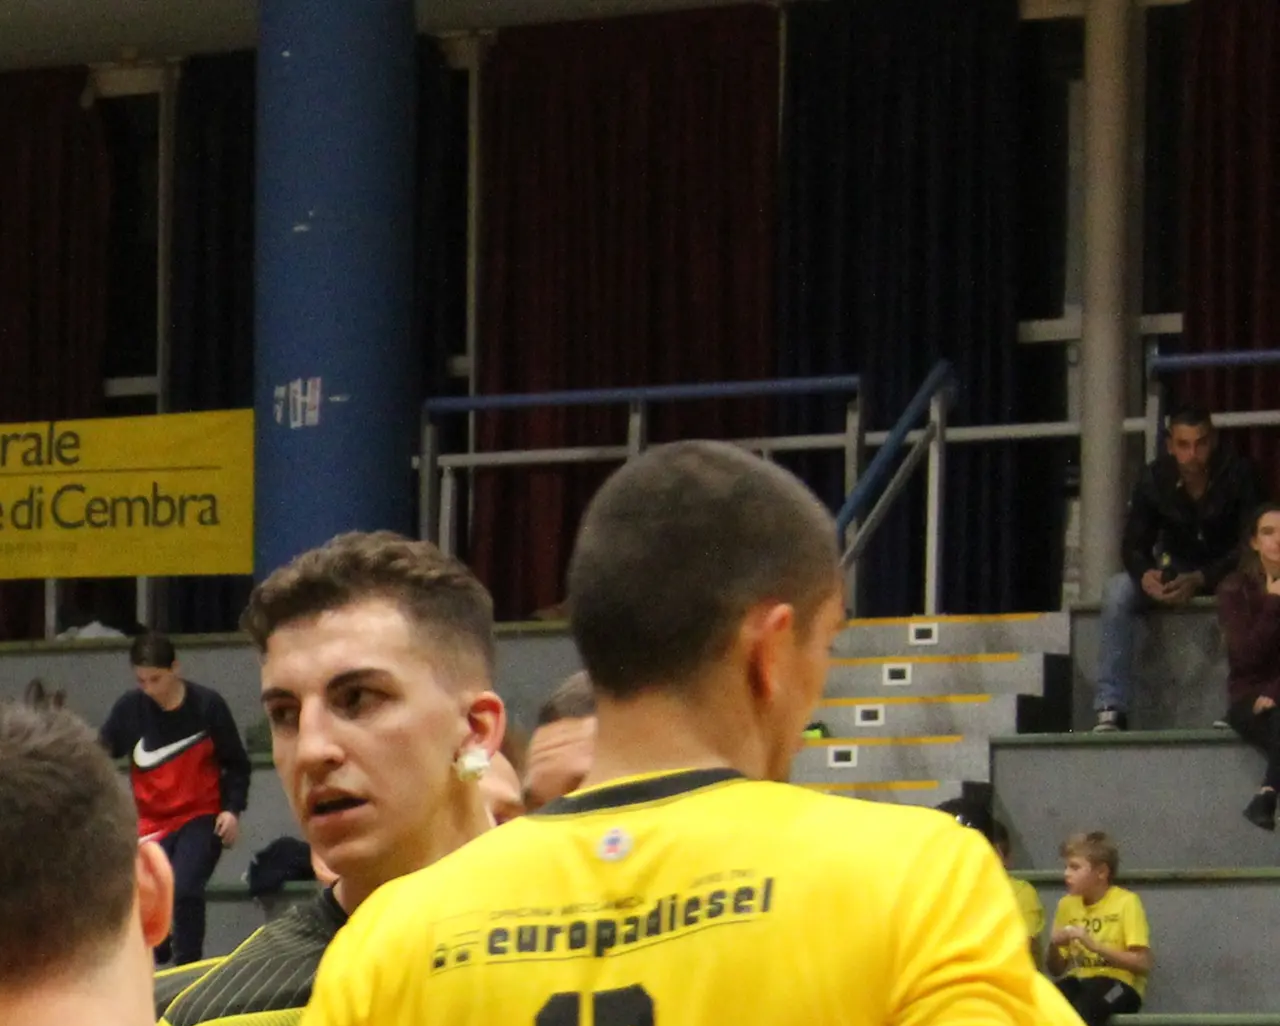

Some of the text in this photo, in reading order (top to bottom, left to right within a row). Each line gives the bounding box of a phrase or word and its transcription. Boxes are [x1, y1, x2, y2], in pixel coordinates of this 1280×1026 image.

[11, 485, 44, 531] di
[51, 482, 221, 531] Cembra
[486, 876, 775, 957] europadiesel
